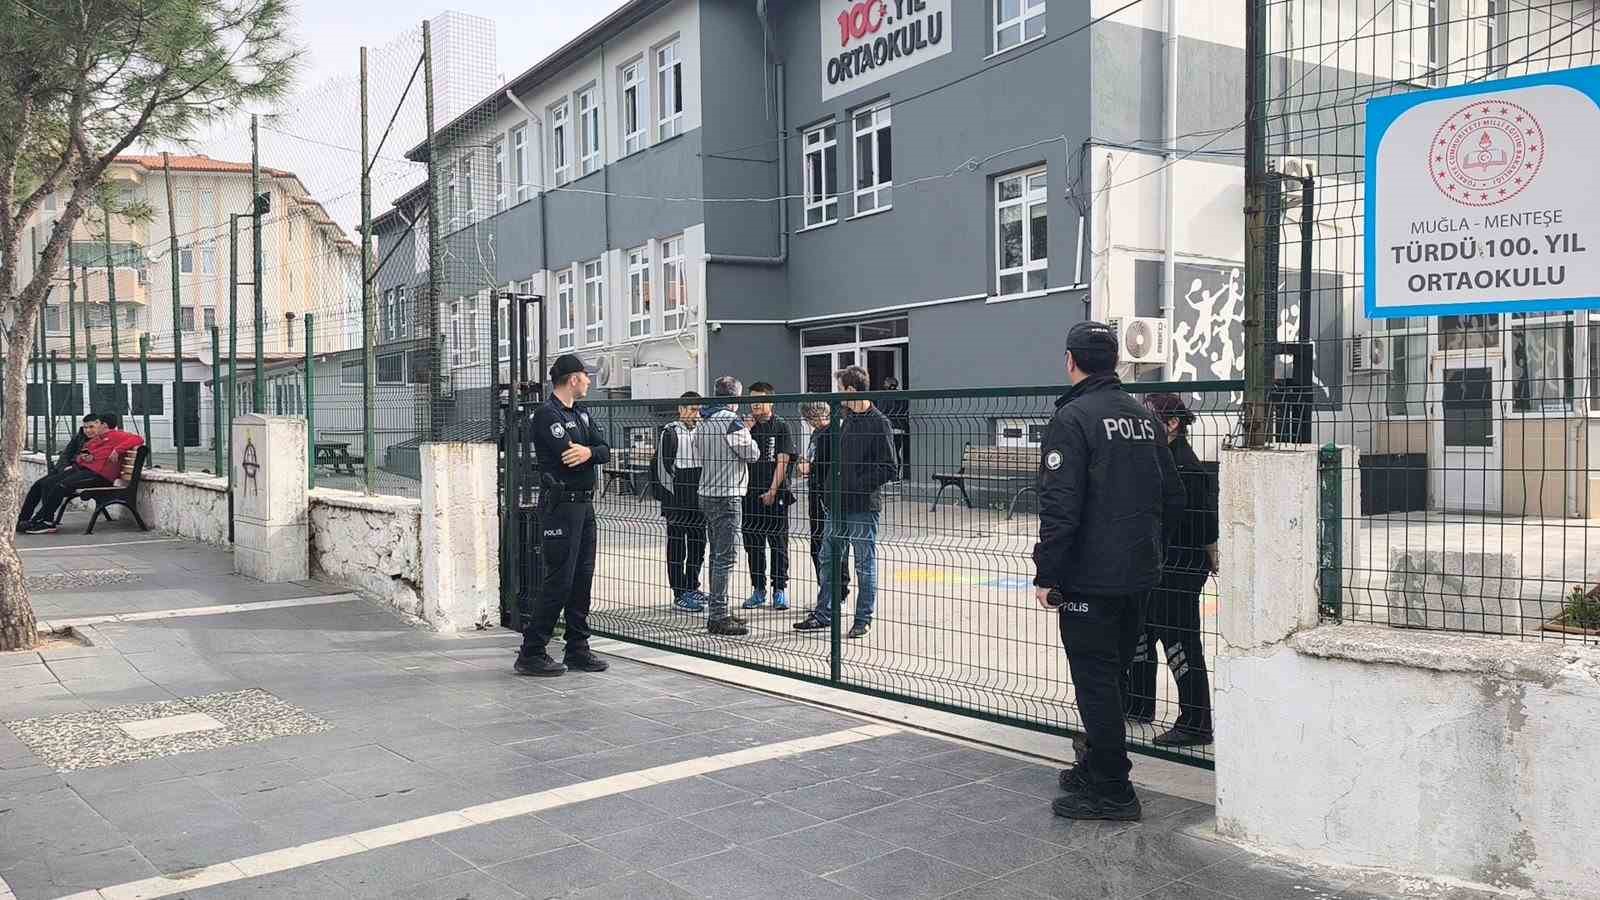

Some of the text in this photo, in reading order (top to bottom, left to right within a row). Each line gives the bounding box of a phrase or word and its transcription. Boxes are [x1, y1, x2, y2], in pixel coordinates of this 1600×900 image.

[827, 11, 943, 84] ORTAOKULU
[1411, 216, 1469, 234] MUĞLA
[1484, 209, 1563, 229] MENTEŞE
[1391, 232, 1586, 264] TÜRDÜ 100. YIL
[1407, 265, 1565, 292] ORTAOKULU
